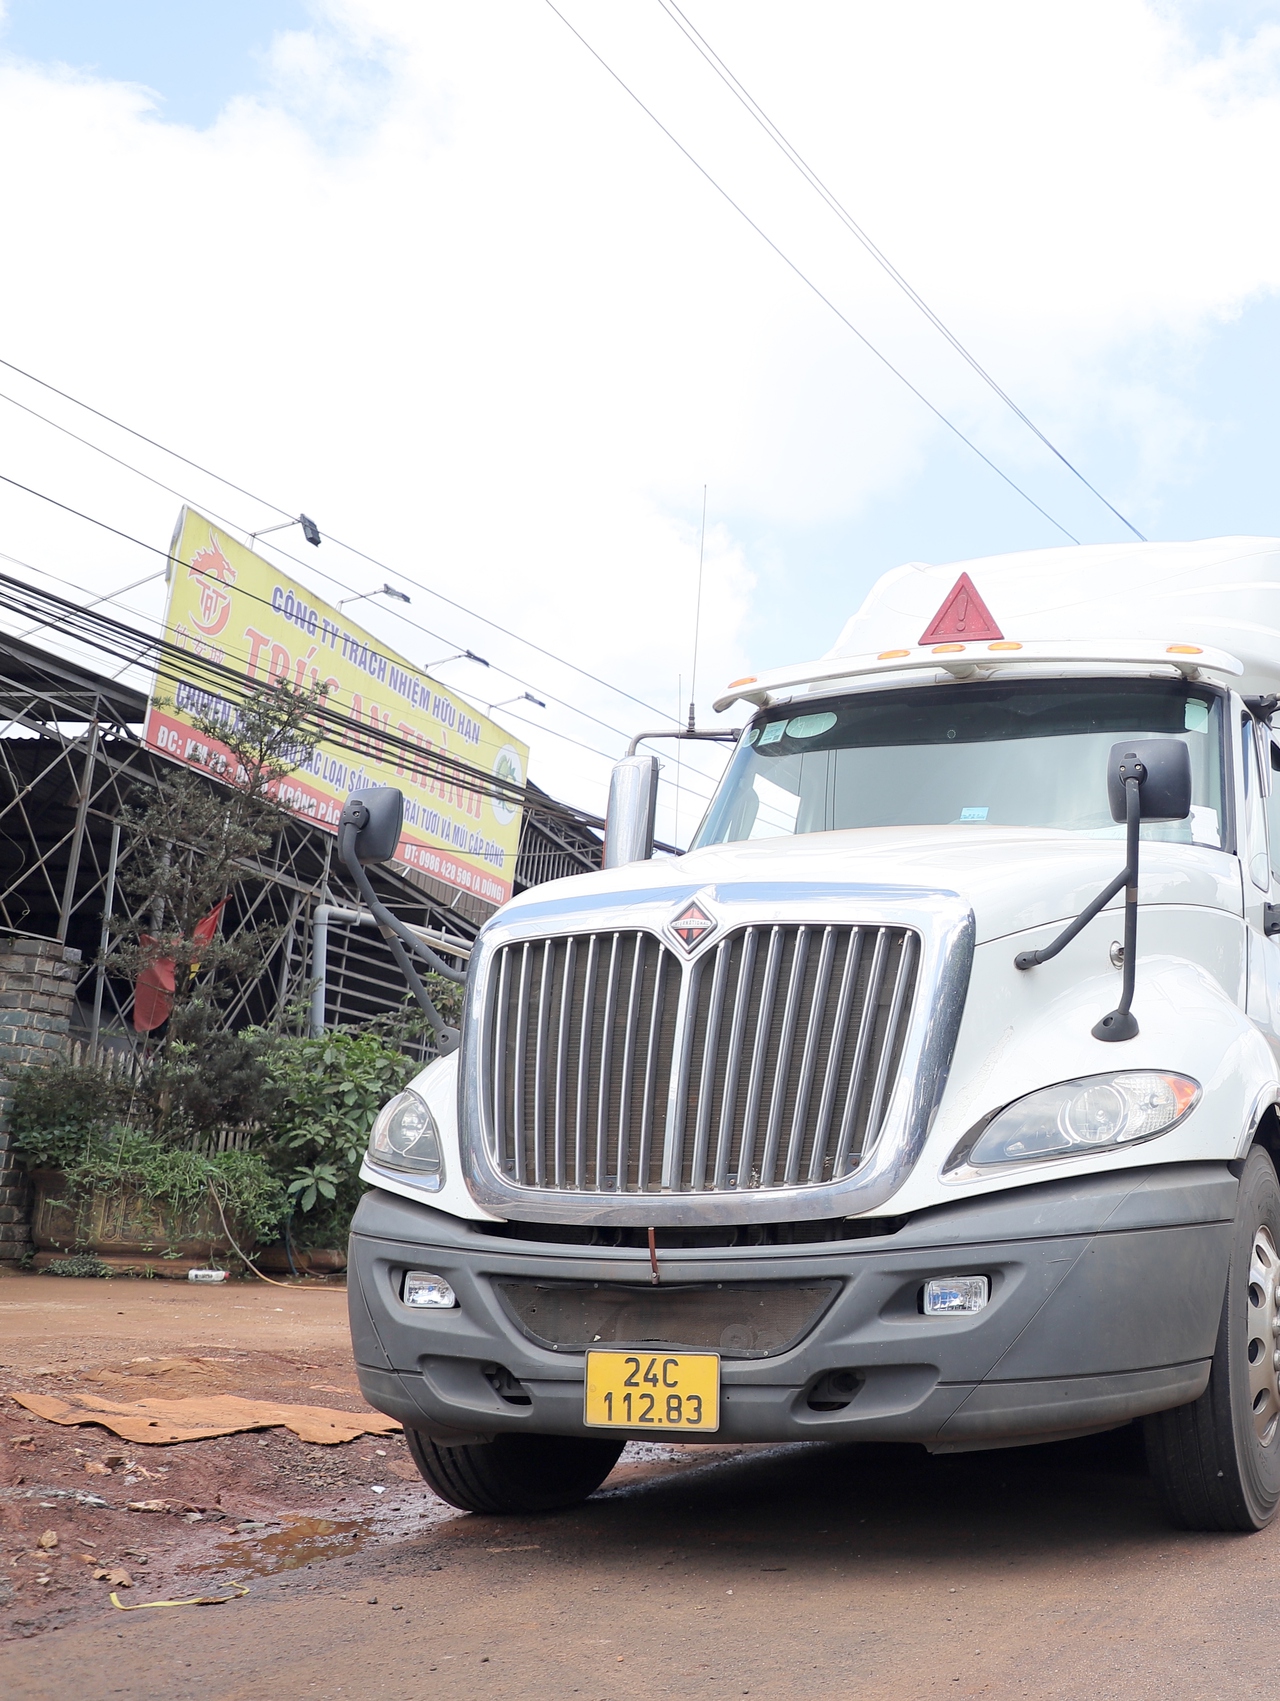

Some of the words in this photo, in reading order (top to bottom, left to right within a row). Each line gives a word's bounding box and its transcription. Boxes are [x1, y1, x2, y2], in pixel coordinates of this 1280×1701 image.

[271, 586, 318, 637] CÔNG
[321, 618, 339, 649] TY
[342, 632, 387, 682] TRÁCH
[388, 665, 430, 711] NHIỆM
[432, 695, 456, 728] HỮU
[457, 712, 480, 745] HẠN
[157, 725, 182, 754] ĐC:
[278, 783, 317, 817] KRÔNG
[318, 800, 340, 827] PẮC
[343, 694, 390, 764] AN
[397, 722, 484, 819] THÀNH
[322, 757, 347, 791] LOẠI
[403, 797, 420, 826] RÁI
[421, 808, 440, 836] TƯƠI
[441, 817, 452, 842] VÀ
[452, 824, 468, 850] MÚI
[469, 830, 483, 857] CẤP
[419, 850, 440, 873] 0986
[441, 860, 455, 880] 428
[457, 867, 472, 887] 596
[604, 1391, 702, 1425] 112.83
[623, 1357, 679, 1388] 24C
